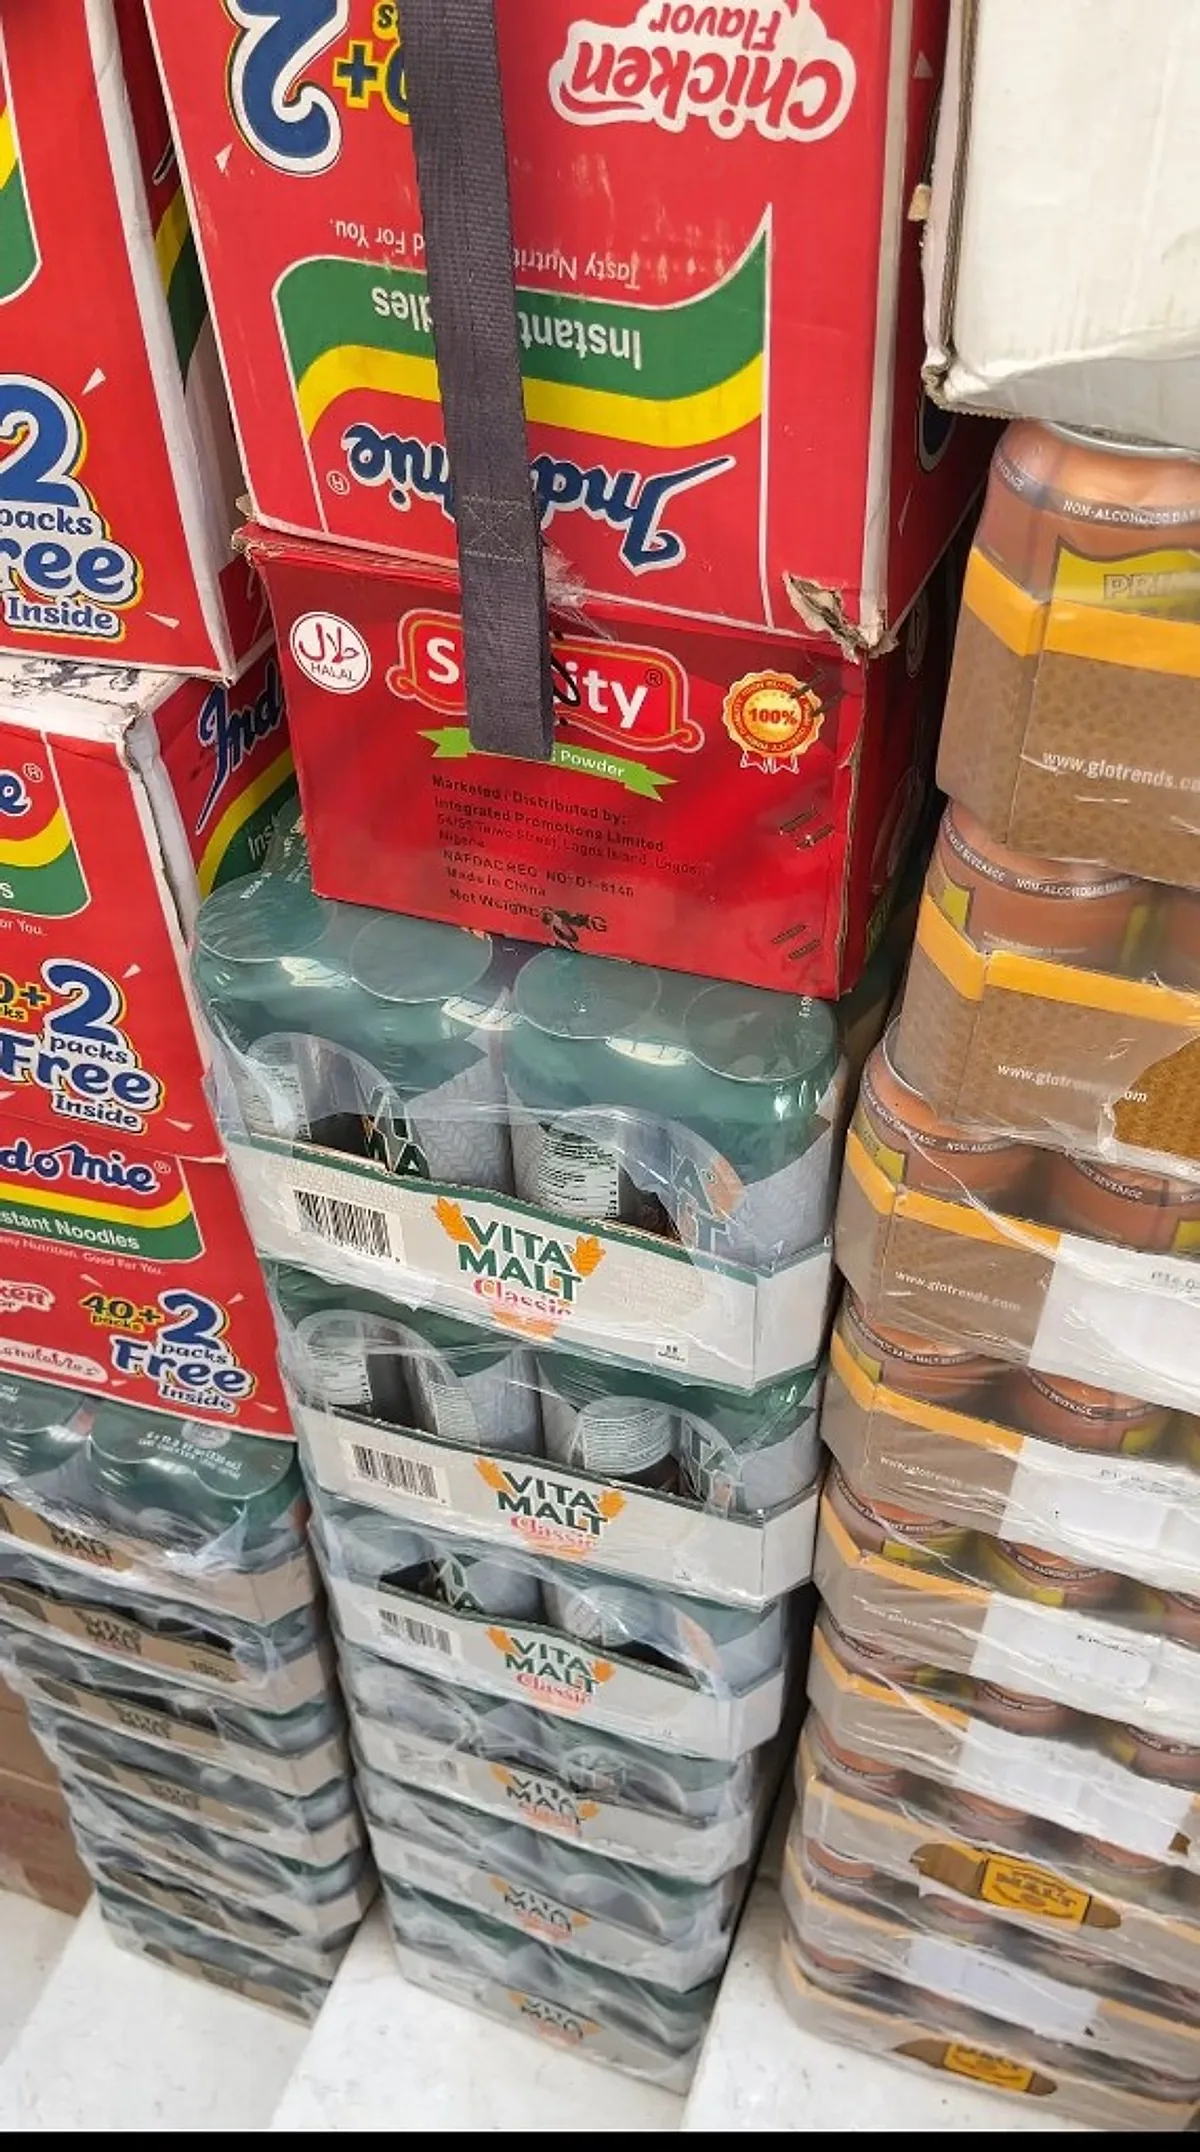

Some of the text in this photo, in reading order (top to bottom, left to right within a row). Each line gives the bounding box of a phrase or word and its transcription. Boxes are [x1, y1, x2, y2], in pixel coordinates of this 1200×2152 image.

[648, 2, 782, 52] Flavor
[562, 40, 844, 131] Chicken
[328, 218, 370, 249] You.
[376, 227, 406, 255] For
[584, 251, 641, 291] Tasty
[517, 311, 642, 371] Instant
[8, 597, 113, 629] Inside
[310, 662, 357, 683] HALAL
[748, 708, 798, 726] 100%
[560, 750, 626, 778] Powder
[432, 775, 501, 799] Marketed
[512, 790, 599, 819] Distributed
[603, 808, 627, 826] by:
[435, 796, 665, 852] Integrated Promotions Limited
[443, 849, 503, 871] NAFDAC
[563, 838, 603, 858] Lagos
[446, 867, 485, 884] Made
[504, 877, 546, 898] China
[449, 888, 475, 904] Net
[16, 918, 48, 937] You.
[48, 964, 120, 1046] 2
[50, 1036, 128, 1065] packs
[0, 1031, 151, 1105] Free
[55, 1092, 138, 1128] Inside
[54, 1218, 141, 1250] Noodles
[462, 1213, 574, 1273] VITA
[82, 1251, 116, 1267] Good
[116, 1258, 138, 1272] For
[457, 1242, 583, 1302] MALT
[81, 1294, 161, 1323] 40+
[161, 1290, 221, 1352] 2
[114, 1337, 246, 1394] Free
[160, 1342, 228, 1367] packs
[161, 1383, 232, 1411] Inside
[502, 1471, 600, 1515] VITA
[497, 1490, 609, 1536] MALT
[504, 1653, 600, 1693] MALT
[510, 1636, 594, 1678] VITA
